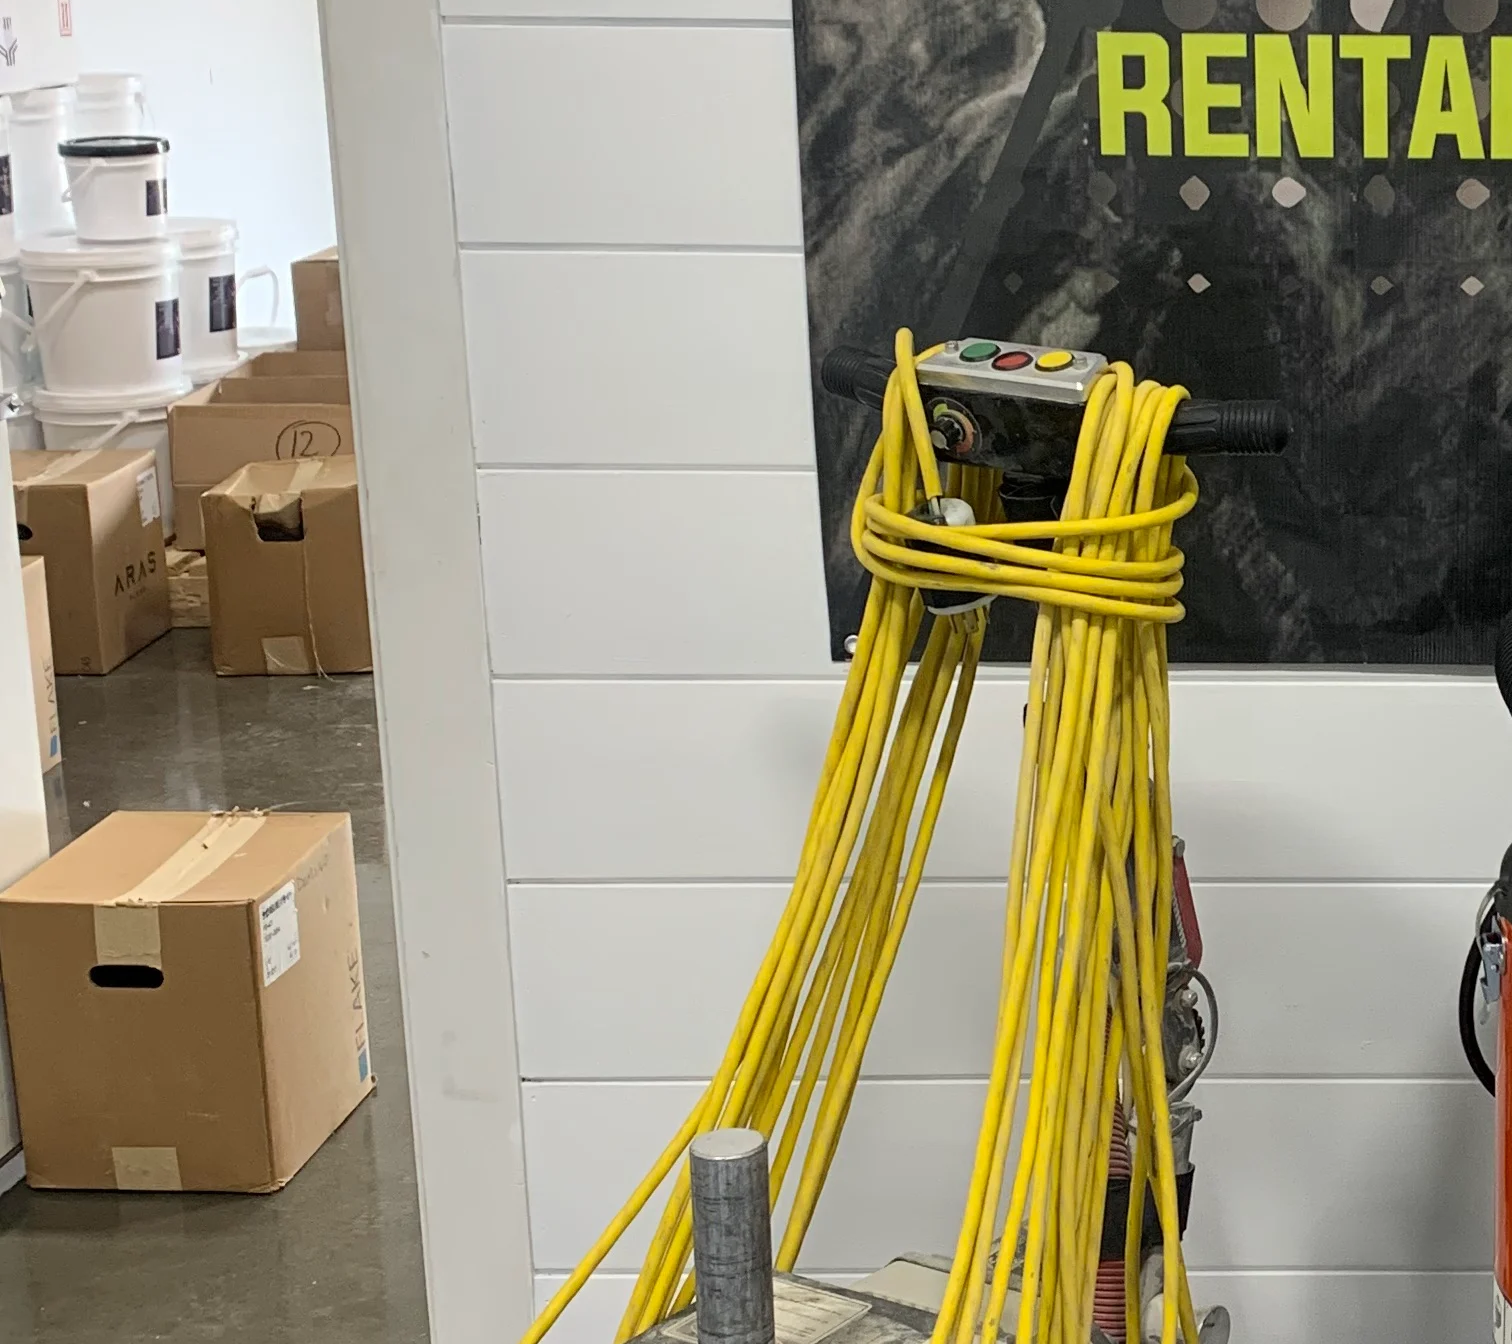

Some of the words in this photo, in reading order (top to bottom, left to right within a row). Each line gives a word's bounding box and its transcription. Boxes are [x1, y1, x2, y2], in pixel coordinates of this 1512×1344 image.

[291, 430, 319, 458] 12
[114, 551, 157, 597] ARAS
[347, 947, 366, 1051] FLAKE
